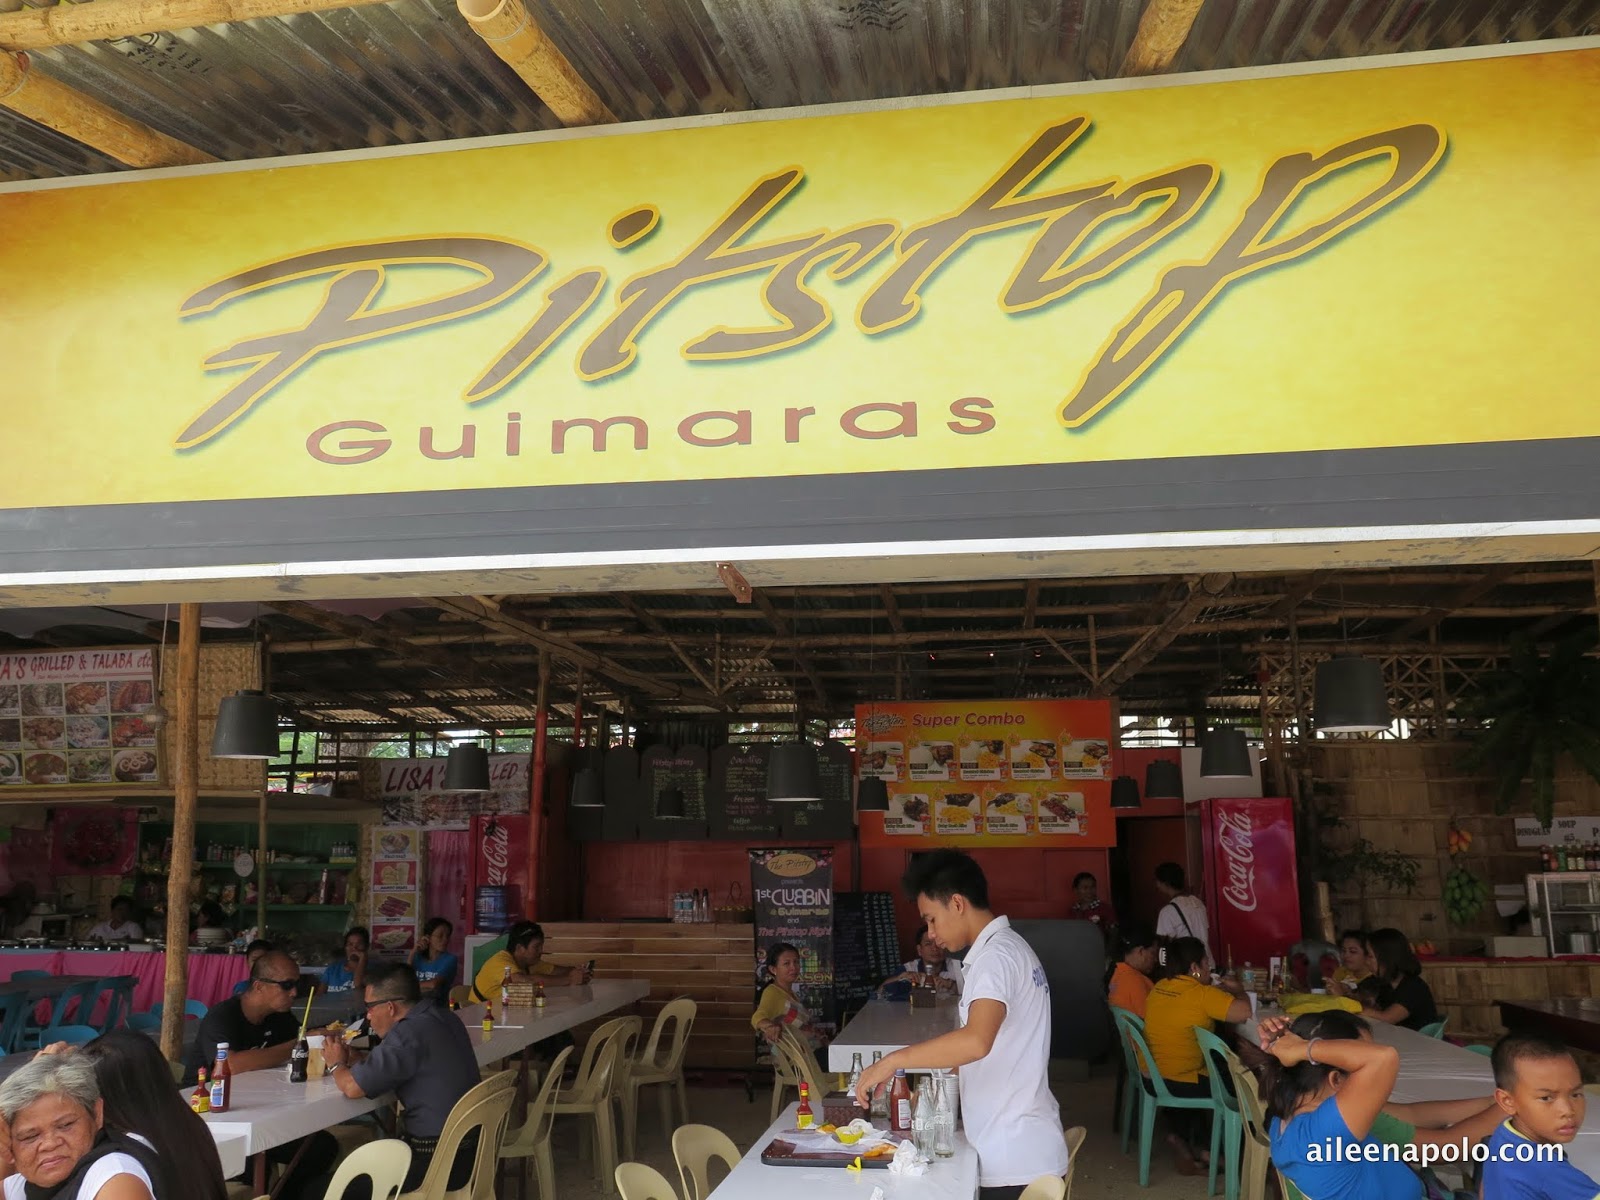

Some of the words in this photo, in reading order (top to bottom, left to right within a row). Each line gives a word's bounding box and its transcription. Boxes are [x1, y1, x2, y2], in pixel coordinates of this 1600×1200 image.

[174, 113, 1447, 449] Pitstop
[306, 397, 996, 466] Guimaras
[0, 656, 26, 680] A'S
[31, 654, 74, 677] GRILLED
[79, 654, 87, 670] &
[93, 652, 133, 669] TALABA
[912, 713, 960, 727] Super
[965, 712, 1026, 726] Combo
[1557, 820, 1577, 829] SOUP
[755, 889, 771, 903] 1st
[758, 927, 775, 937] The
[795, 972, 833, 983] ASON
